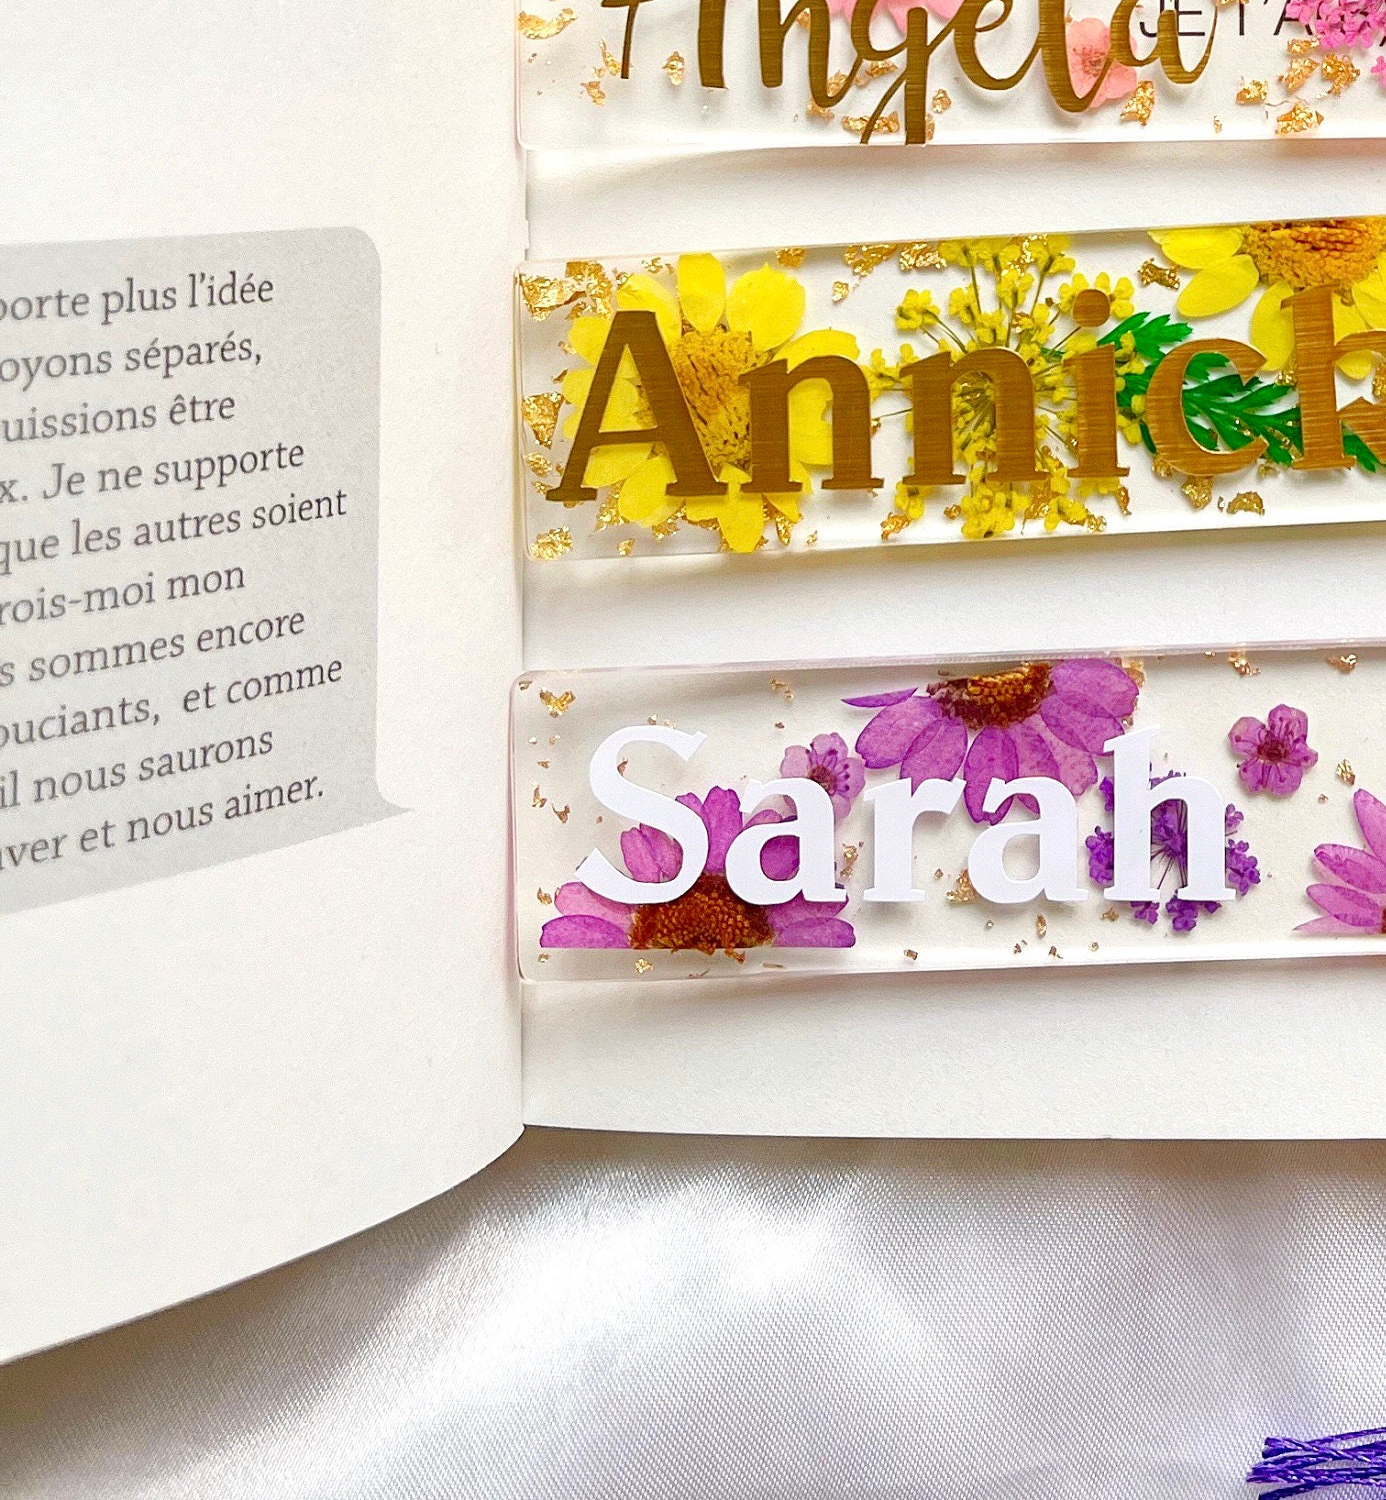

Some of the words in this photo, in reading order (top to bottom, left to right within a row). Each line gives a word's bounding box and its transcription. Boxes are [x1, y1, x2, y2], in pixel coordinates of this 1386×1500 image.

[100, 276, 177, 326] plus
[187, 269, 274, 309] l’idée
[0, 350, 113, 393] oyons
[124, 330, 262, 380] séparés,
[1, 402, 157, 443] uissions
[168, 393, 236, 426] être
[42, 462, 86, 501] Je
[97, 465, 143, 493] ne
[153, 441, 305, 491] supporte
[71, 517, 121, 556] les
[133, 509, 241, 547] autres
[251, 488, 348, 530] soient
[166, 566, 246, 600] mon
[28, 633, 185, 683] sommes
[196, 612, 305, 653] encore
[182, 681, 217, 714] et
[226, 659, 343, 705] comme
[32, 762, 126, 804] nous
[138, 731, 274, 782] saurons
[0, 834, 68, 871] ver
[79, 820, 117, 853] et
[126, 802, 214, 844] nous
[223, 775, 324, 820] aimer.
[574, 725, 1237, 904] Sarah
